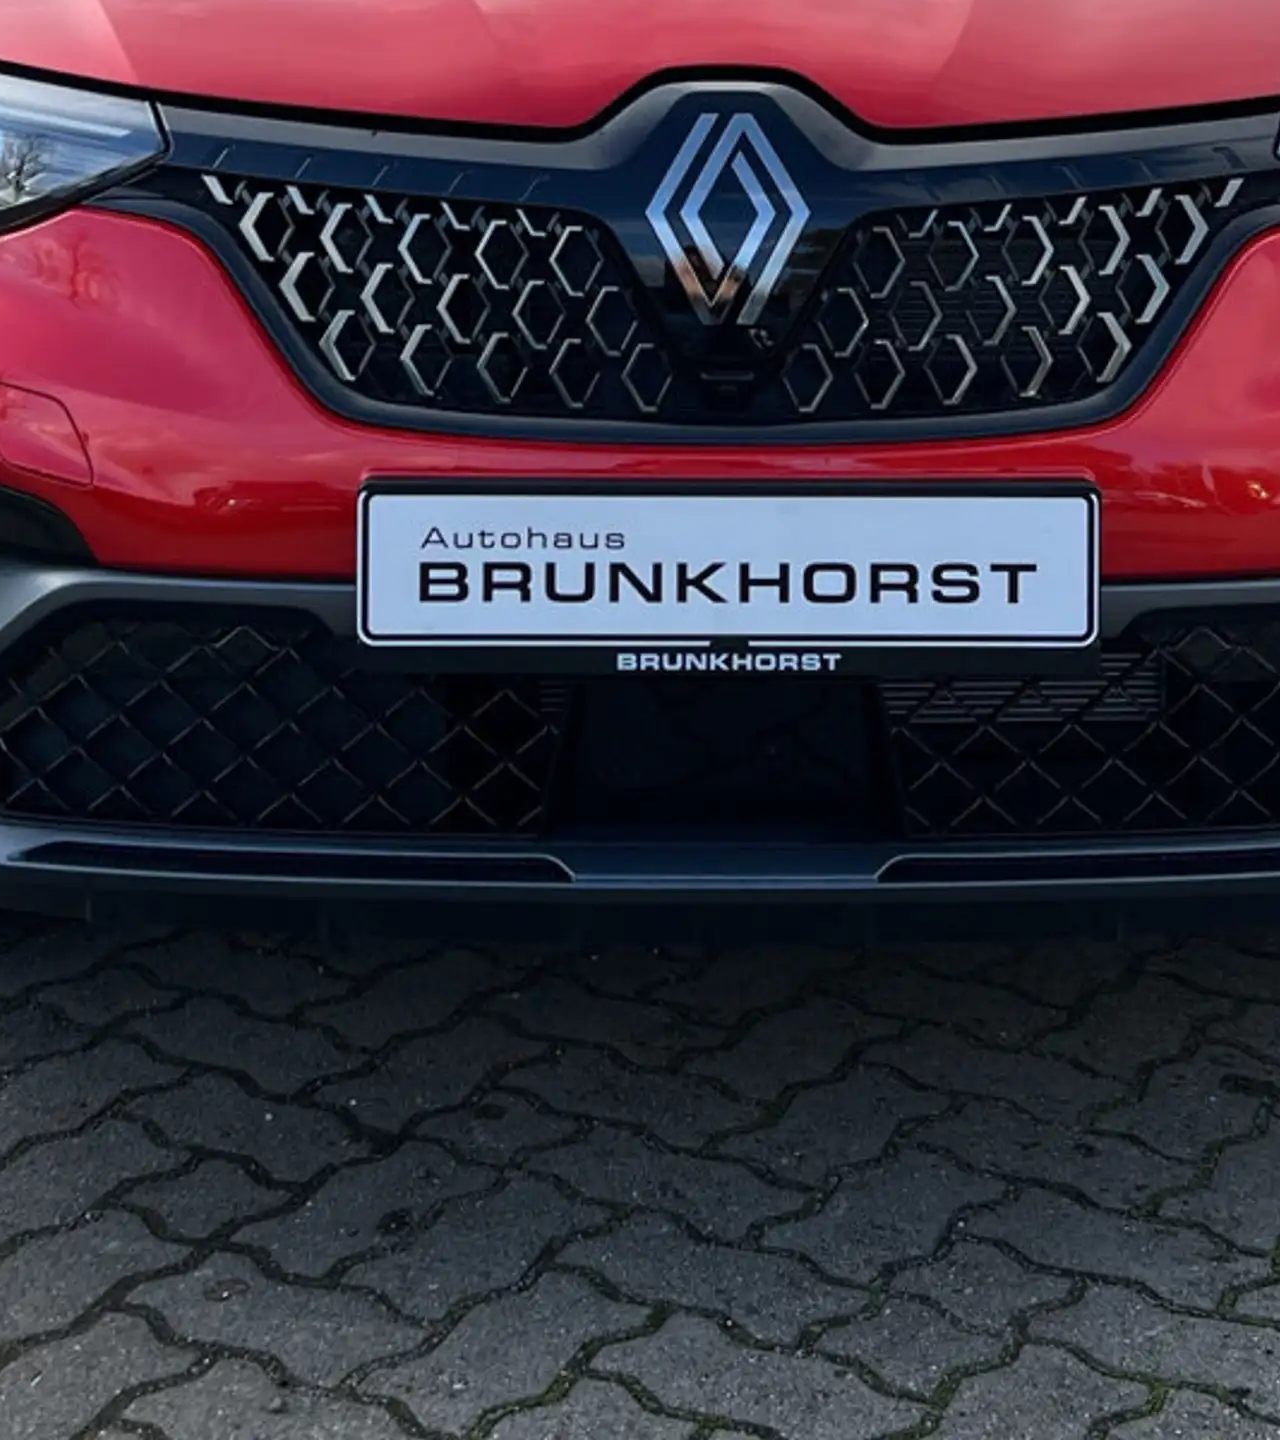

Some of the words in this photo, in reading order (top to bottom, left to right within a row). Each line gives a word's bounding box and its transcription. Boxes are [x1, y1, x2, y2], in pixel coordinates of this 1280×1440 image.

[420, 525, 626, 550] Autohaus
[417, 560, 1038, 604] BRUNKHORST
[616, 652, 842, 672] BRUNKHORST
